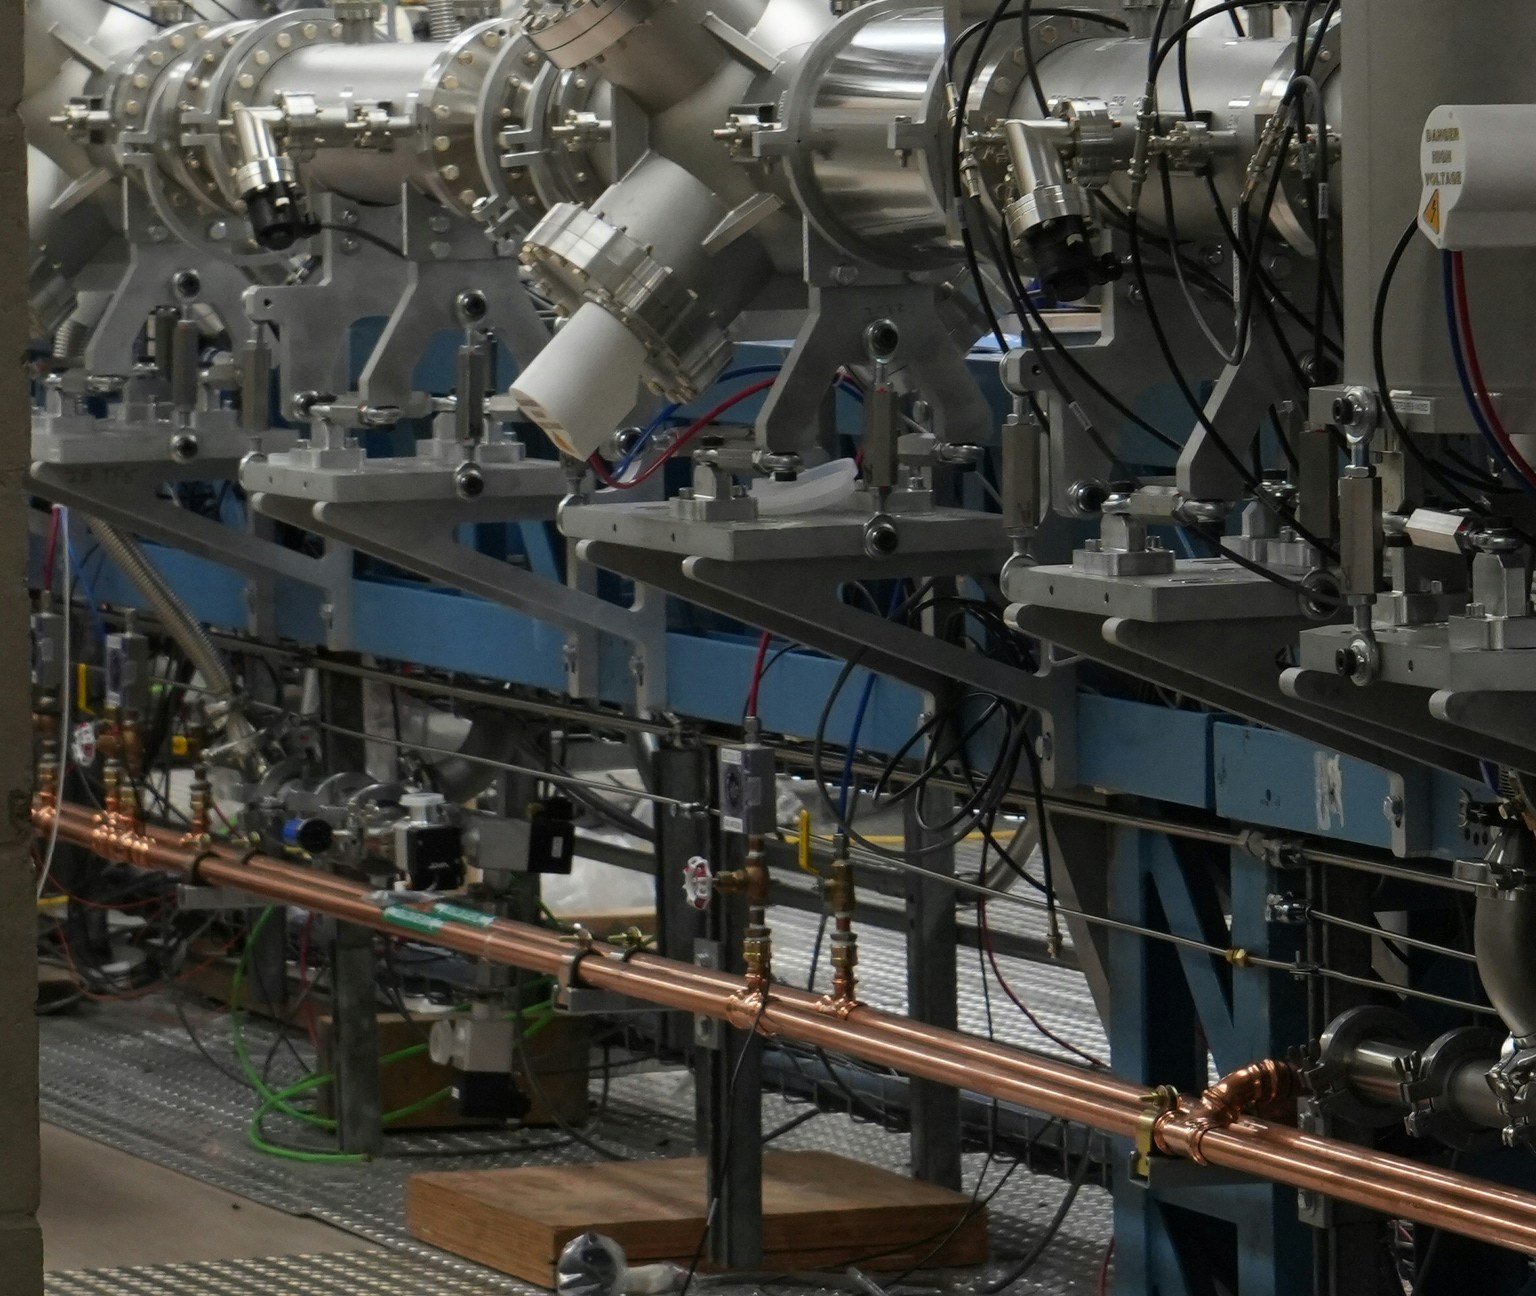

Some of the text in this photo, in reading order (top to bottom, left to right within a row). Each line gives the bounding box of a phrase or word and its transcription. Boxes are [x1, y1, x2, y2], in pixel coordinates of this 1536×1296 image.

[1426, 127, 1460, 142] DANGER
[1431, 150, 1452, 164] HIGH
[1425, 171, 1462, 186] VOLTAGE
